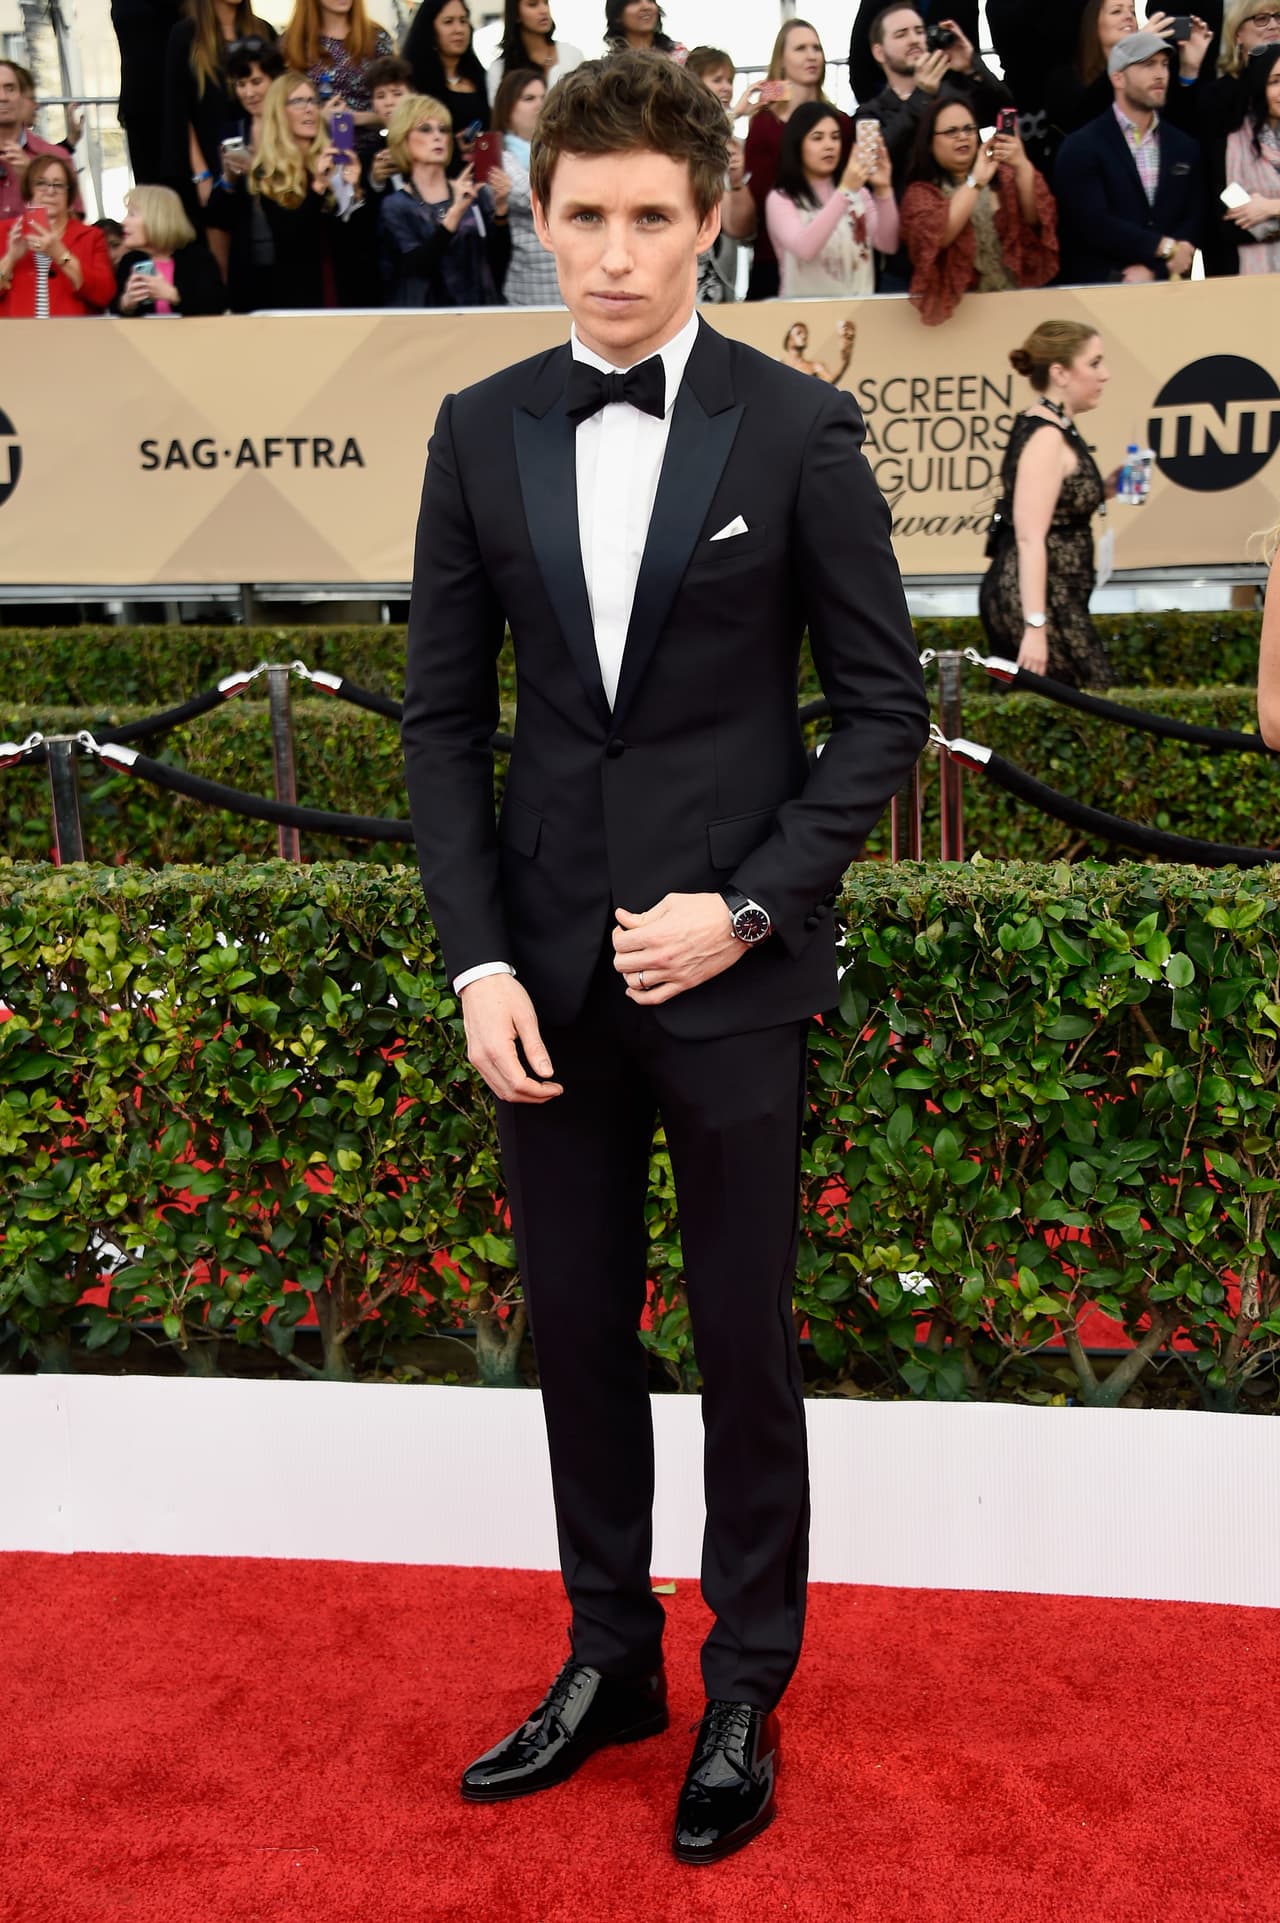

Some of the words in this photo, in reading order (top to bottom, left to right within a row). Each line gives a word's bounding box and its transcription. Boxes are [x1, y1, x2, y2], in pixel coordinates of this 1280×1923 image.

[858, 374, 1012, 414] SCREEN
[865, 414, 1013, 453] ACTORS
[1149, 399, 1280, 459] TNT
[874, 456, 992, 492] GUILD
